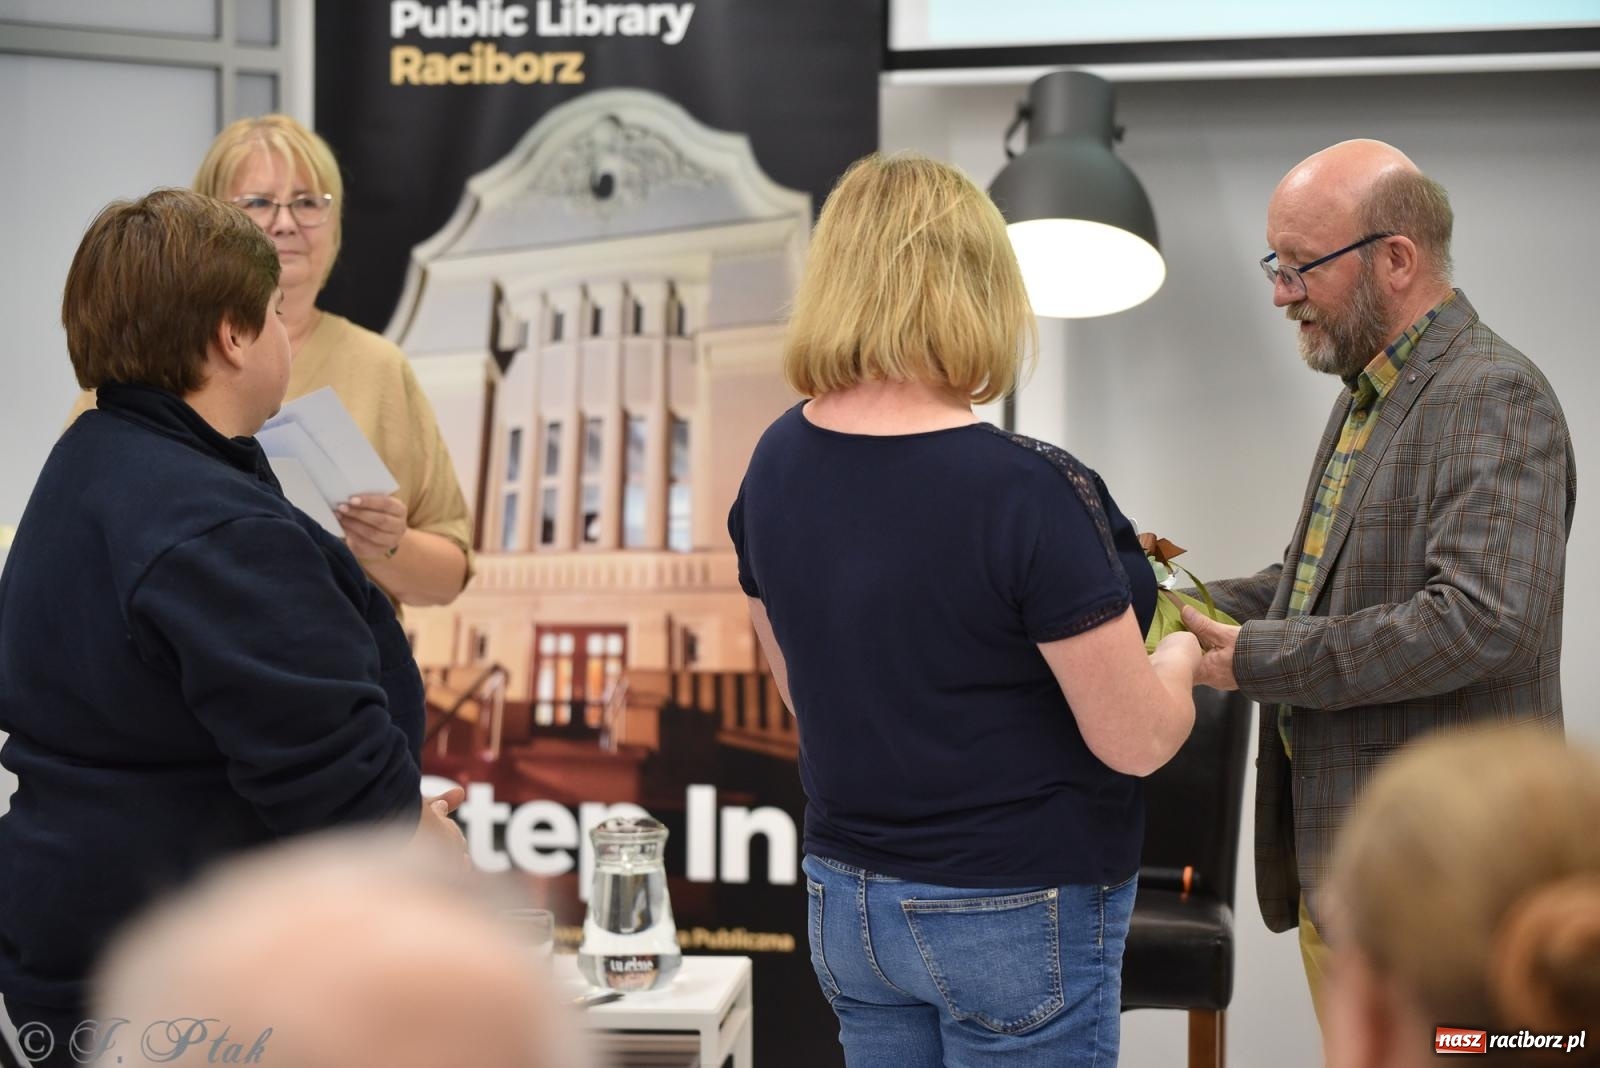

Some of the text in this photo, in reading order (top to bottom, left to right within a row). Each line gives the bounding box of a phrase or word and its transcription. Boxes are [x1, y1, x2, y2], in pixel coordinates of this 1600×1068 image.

[391, 0, 696, 45] Public Library
[391, 42, 585, 85] Raciborz
[686, 784, 798, 884] In
